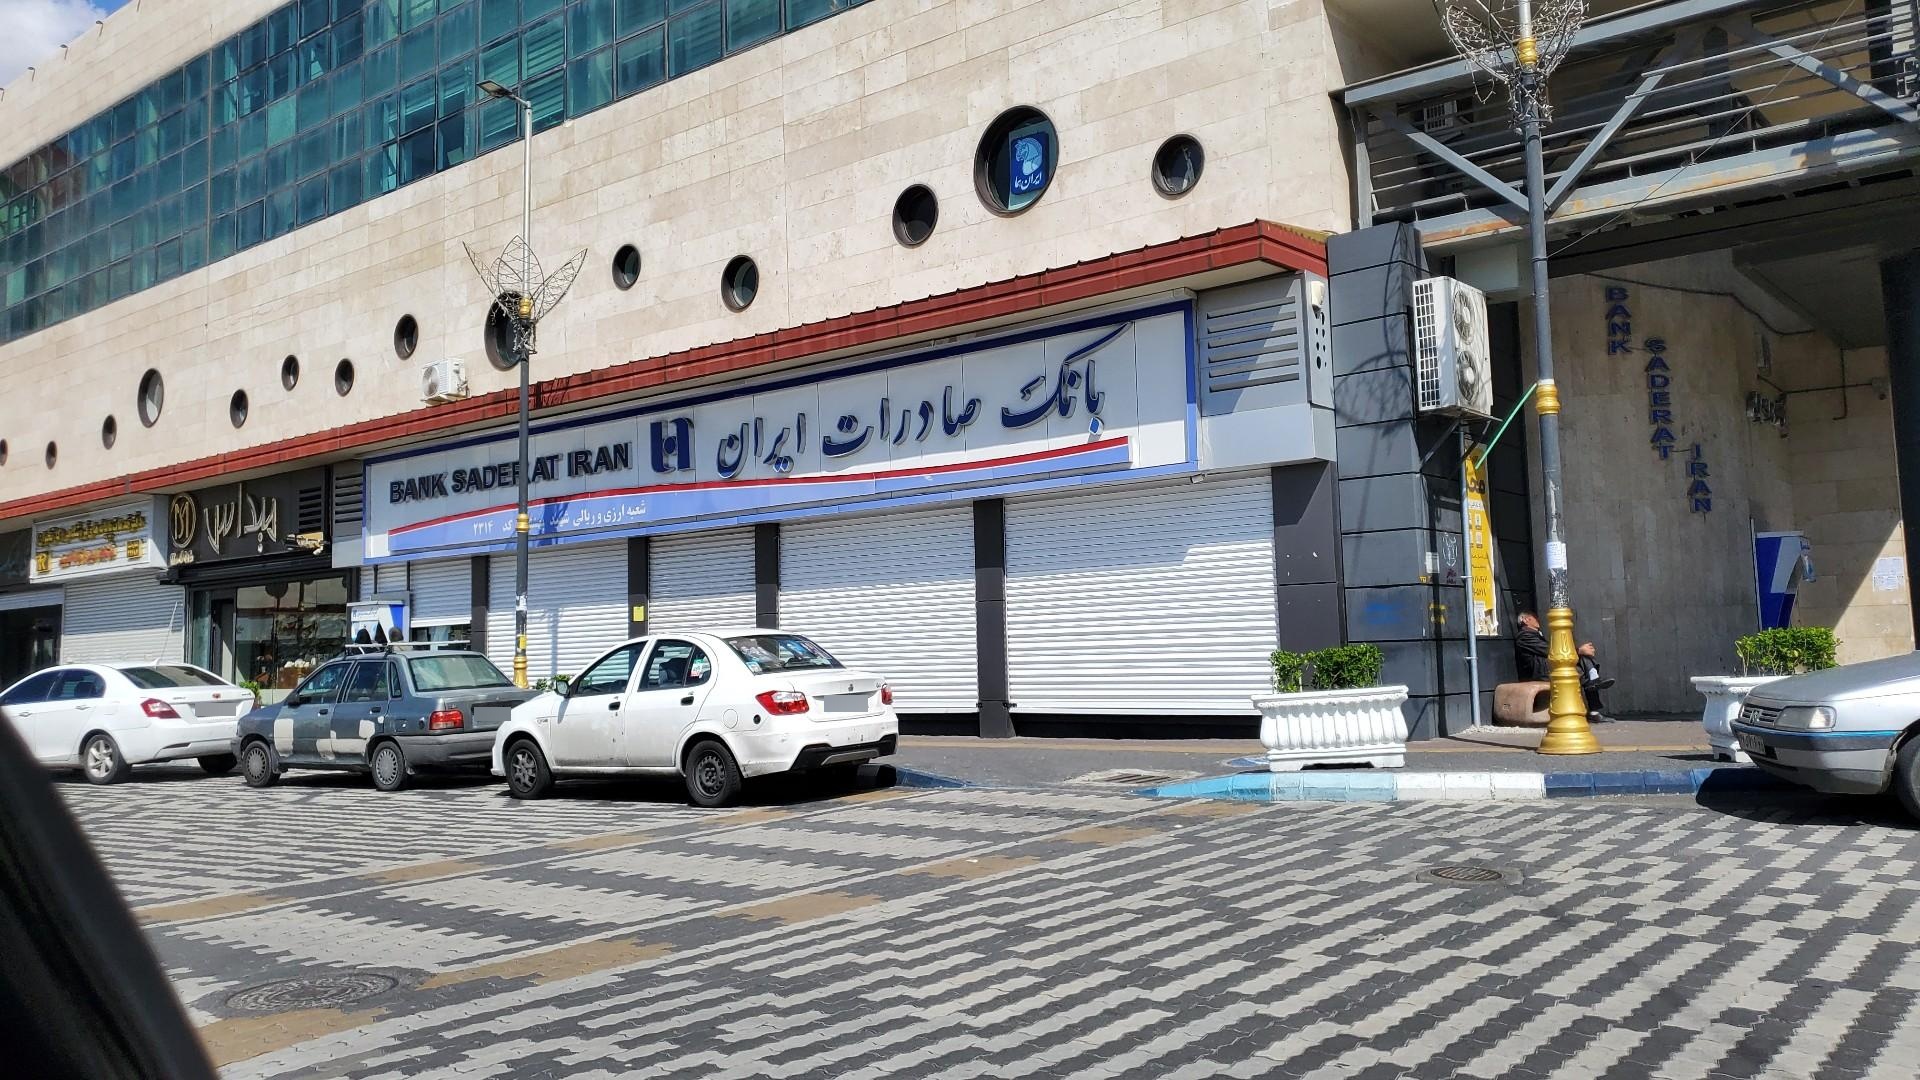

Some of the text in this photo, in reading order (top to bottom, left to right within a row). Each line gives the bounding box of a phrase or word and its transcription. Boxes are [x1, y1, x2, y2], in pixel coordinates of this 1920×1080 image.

[1606, 288, 1632, 355] BANK
[716, 322, 1133, 479] بانک صادرات ایران
[1644, 338, 1676, 458] SADERAT
[389, 472, 448, 504] BANK
[568, 442, 632, 477] IRAN
[1687, 443, 1713, 514] IRAN
[603, 506, 625, 524] ارزی
[626, 500, 646, 519] شعبه
[473, 519, 494, 537] ۲۳۱۴
[502, 519, 513, 532] کد
[572, 511, 596, 528] ریالی
[596, 515, 603, 525] و
